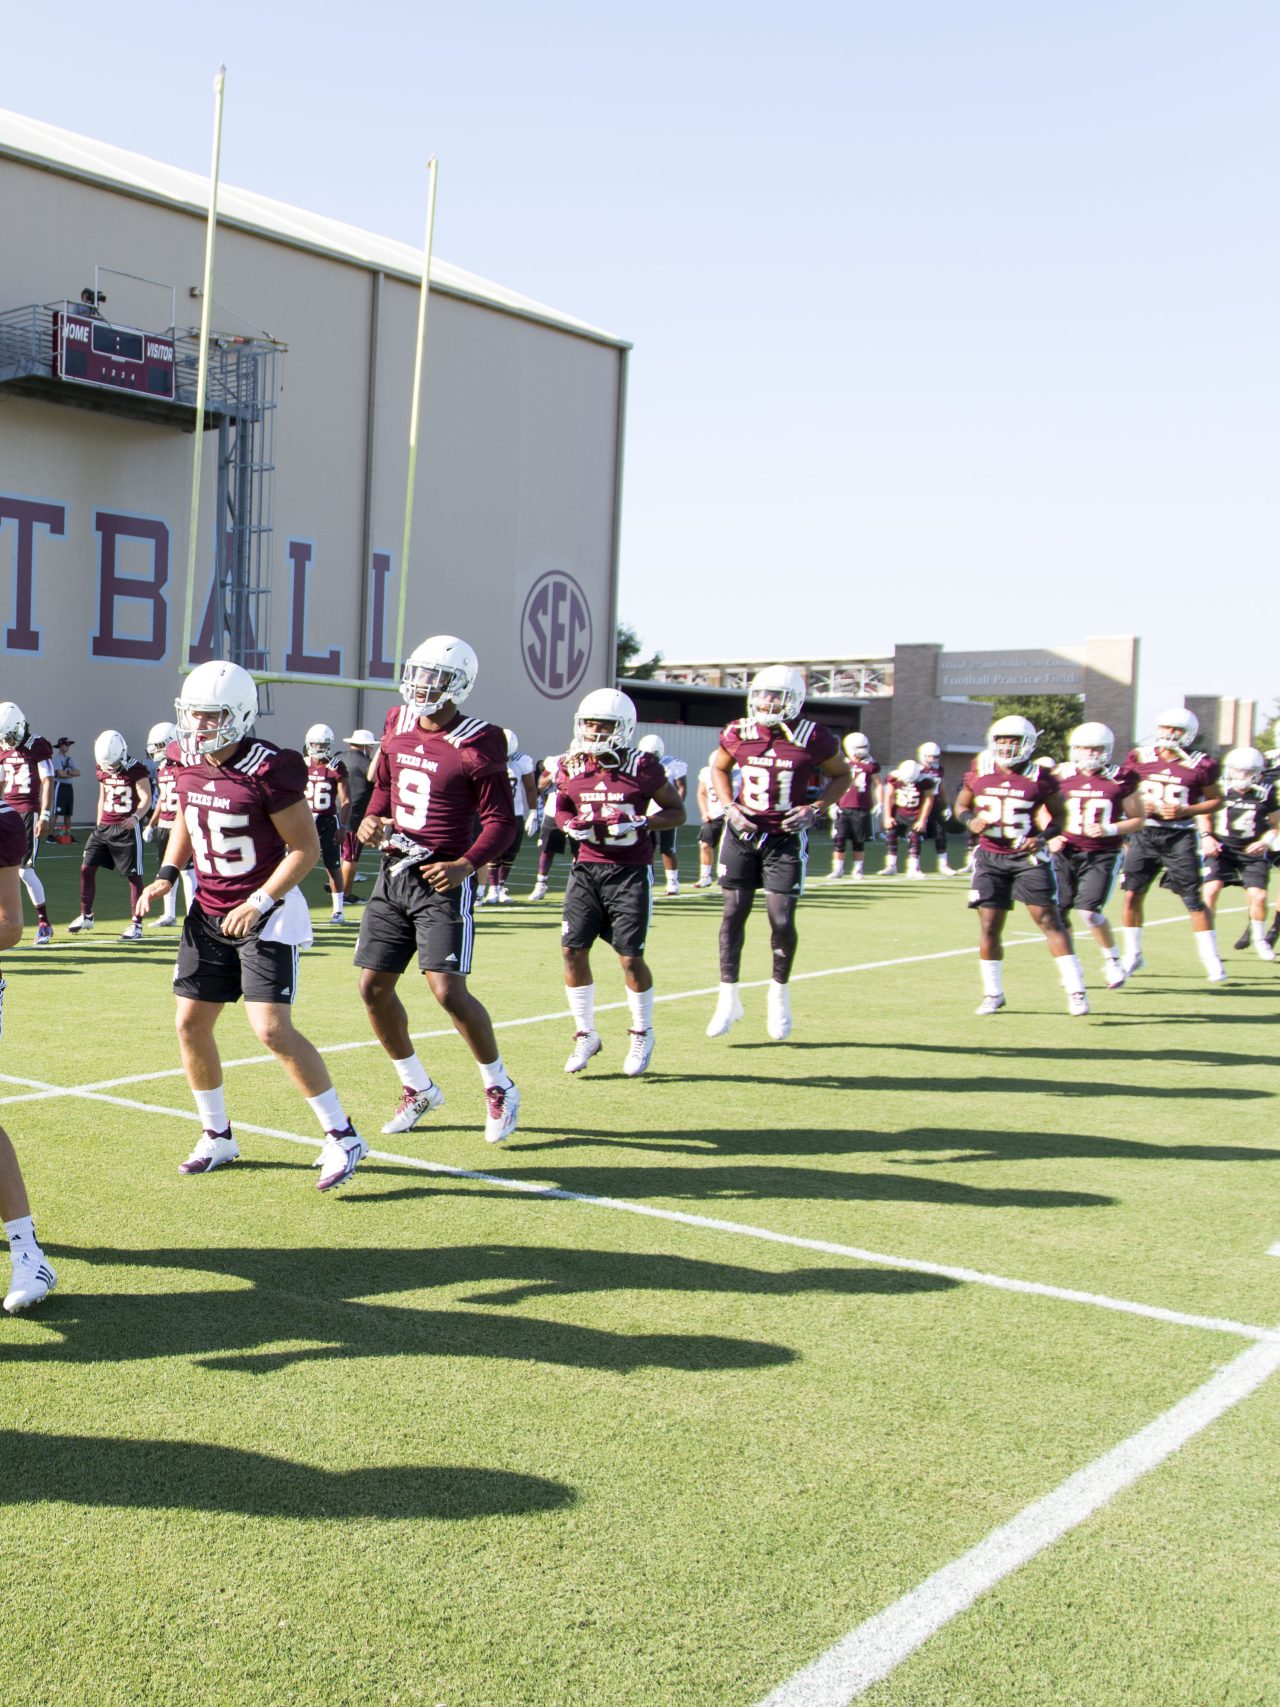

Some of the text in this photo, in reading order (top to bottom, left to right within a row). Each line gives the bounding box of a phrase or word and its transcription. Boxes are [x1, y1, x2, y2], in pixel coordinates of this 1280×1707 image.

[62, 322, 89, 342] HOME
[147, 342, 173, 362] VISITOR
[527, 581, 587, 689] SEC
[943, 674, 990, 685] Football
[993, 673, 1042, 685] Practice
[396, 753, 421, 767] TEXAS
[747, 756, 773, 767] TEXAS
[580, 792, 606, 802] TEXAS
[740, 764, 795, 812] 81
[187, 791, 214, 806] TEXAS
[395, 768, 431, 830] 9
[1065, 797, 1113, 837] 10
[1216, 807, 1257, 838] 14
[184, 804, 257, 877] 15
